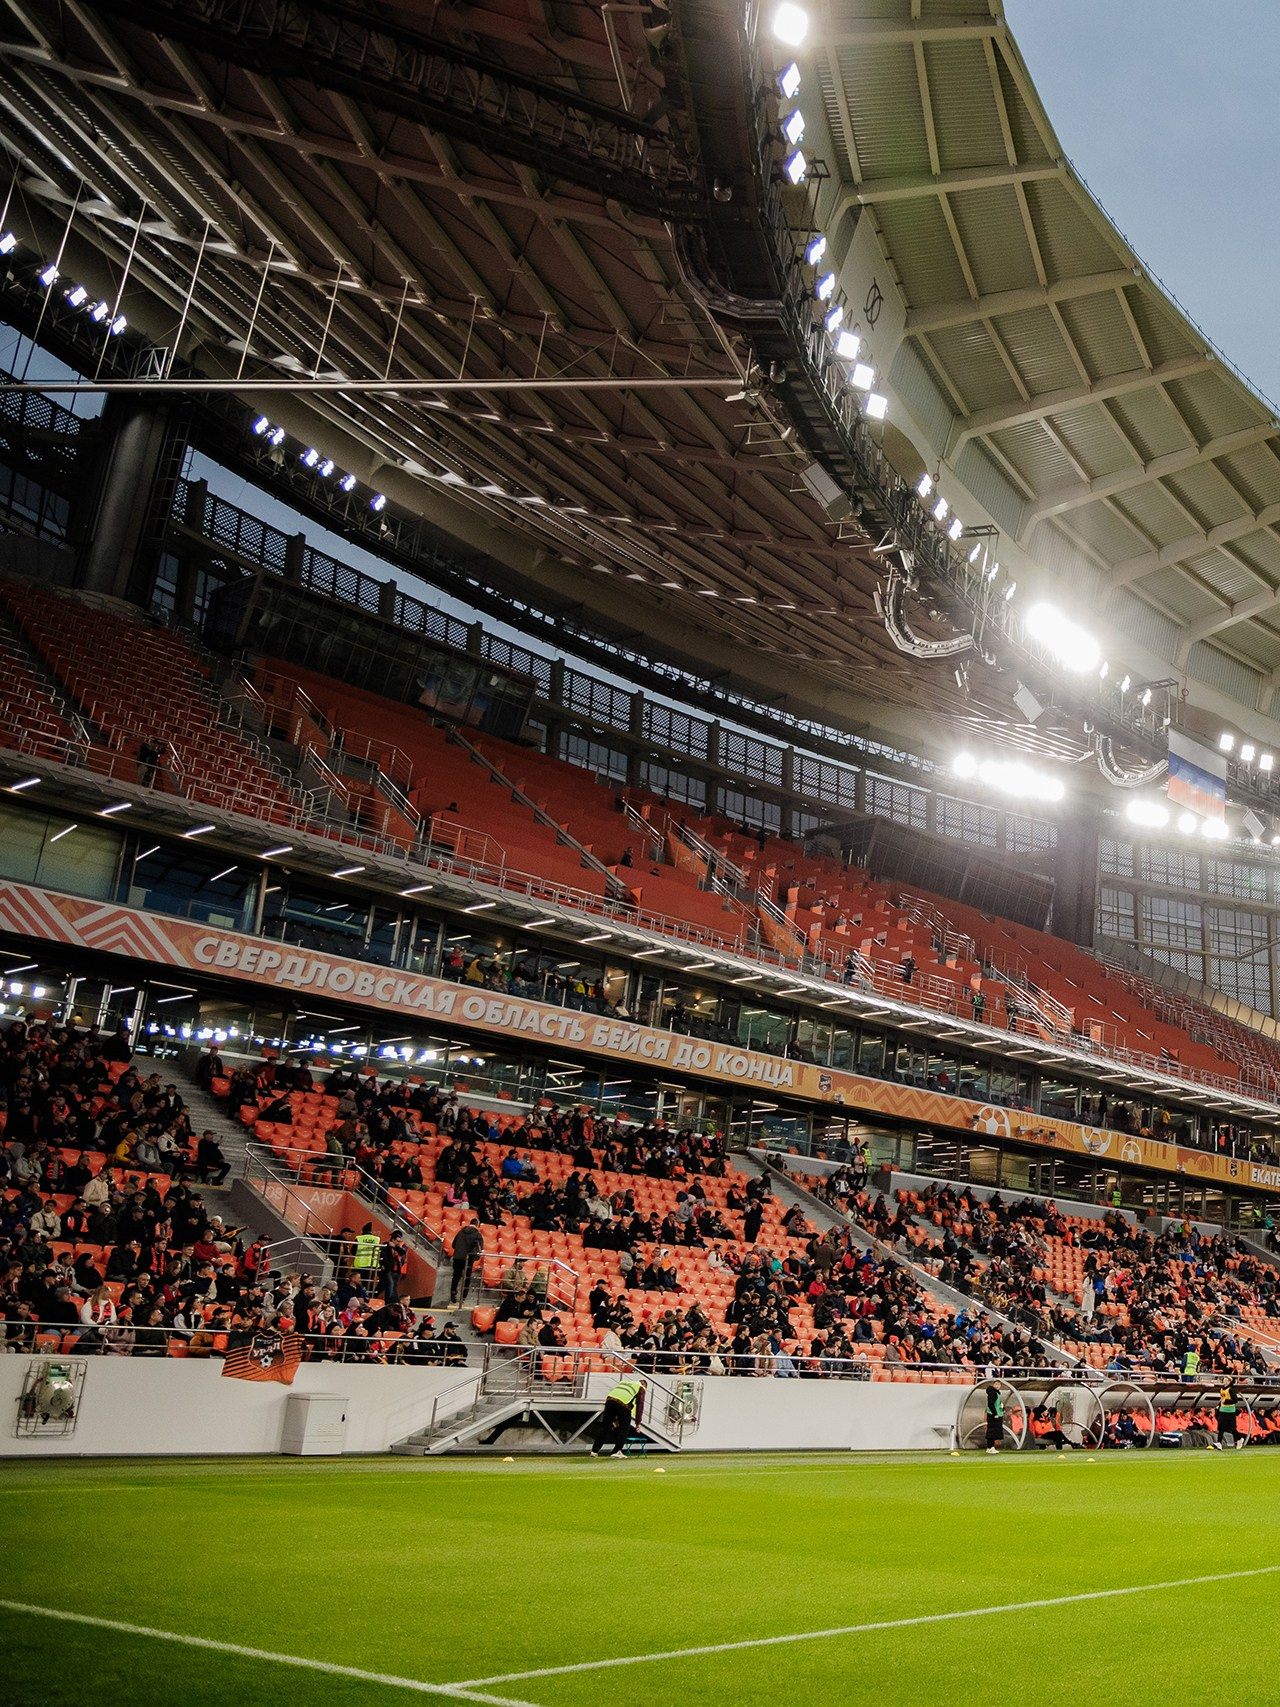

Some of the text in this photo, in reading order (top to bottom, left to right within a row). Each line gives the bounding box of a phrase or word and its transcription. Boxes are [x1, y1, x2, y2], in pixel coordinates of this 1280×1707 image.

[193, 937, 793, 1088] СВЕРДЛОВСКАЯ ОБЛАСТЬ БЕЙСЯ ДО КОНЦА
[309, 1191, 343, 1206] A107
[253, 1342, 281, 1357] УРАЛ
